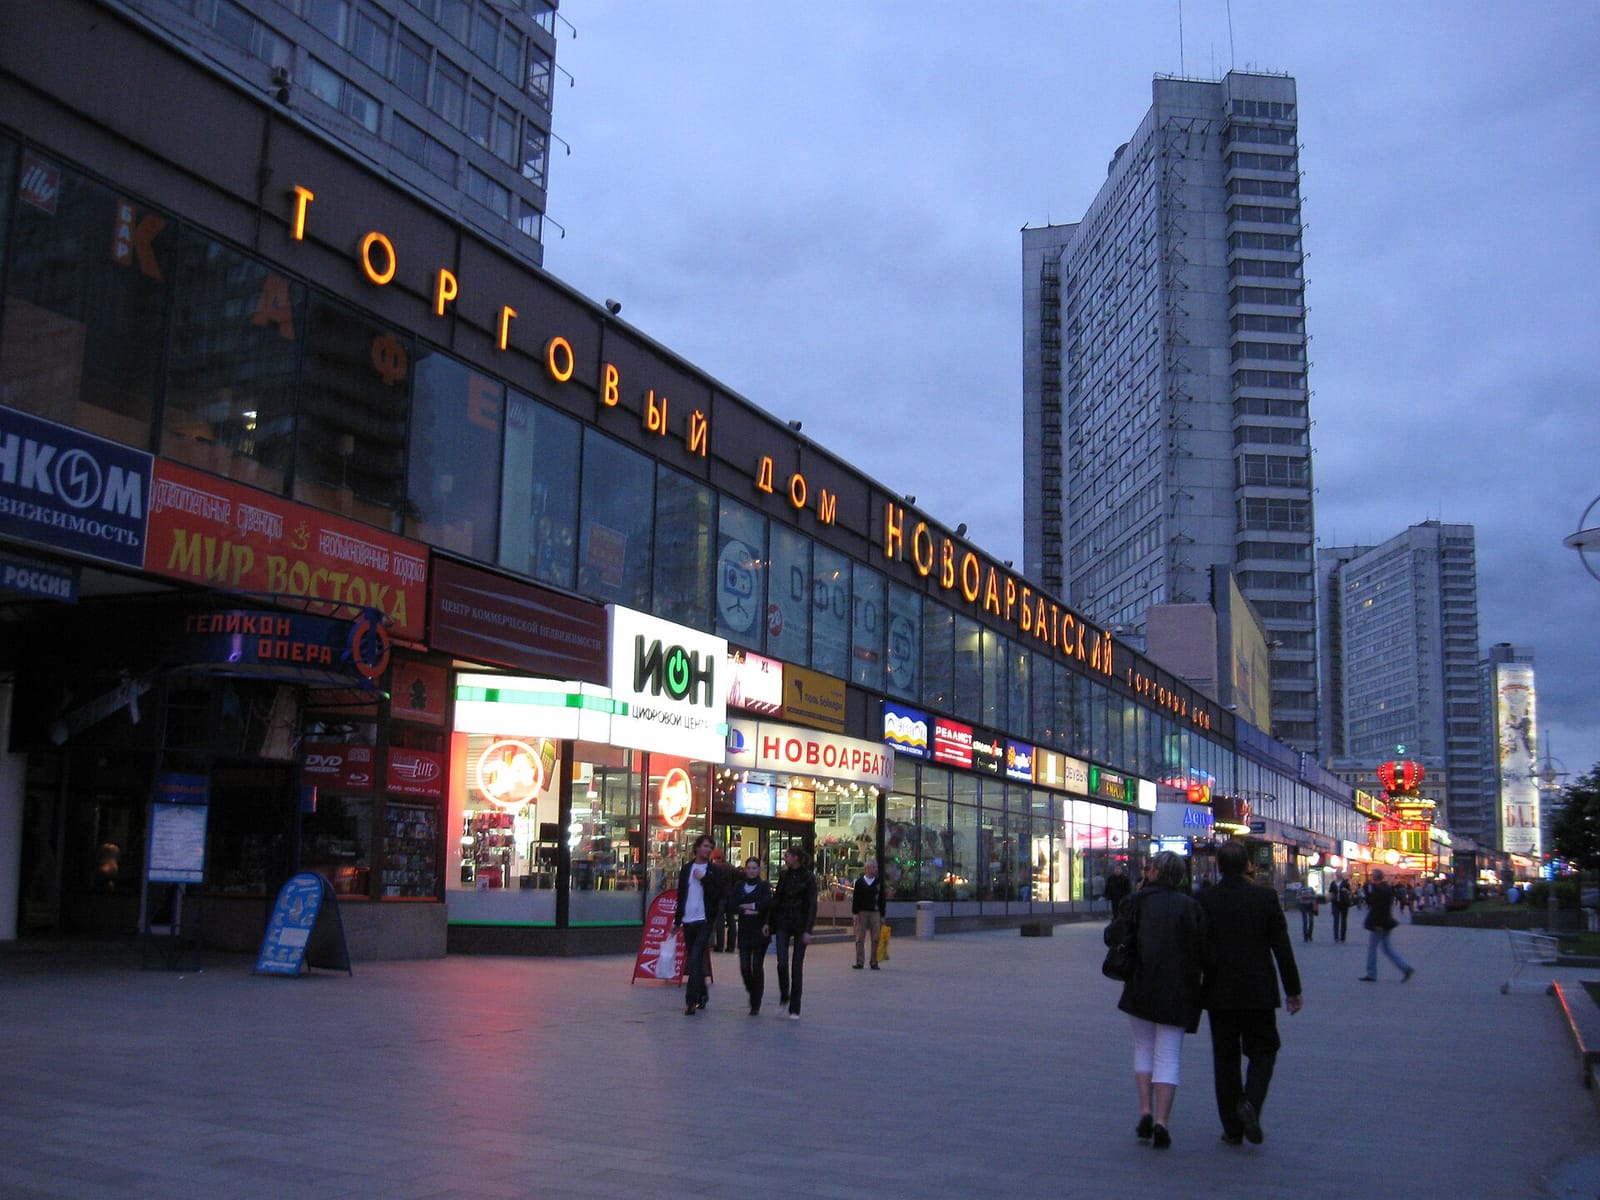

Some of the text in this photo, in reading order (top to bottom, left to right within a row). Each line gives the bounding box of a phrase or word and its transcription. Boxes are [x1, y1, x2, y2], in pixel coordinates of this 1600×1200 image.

[115, 204, 133, 259] БАР
[293, 185, 836, 526] ТОРГОВЫЙ ДОМ
[4, 565, 72, 598] РОССИЯ
[167, 528, 408, 629] МИР ВОСТОКА
[885, 502, 1113, 677] НОВОАРБАТСКИЙ
[186, 615, 291, 637] ГЕЛИКОН
[440, 599, 471, 616] ЦЕНТР
[471, 607, 539, 635] КОММЕРЧЕСКОЙ
[258, 639, 332, 665] ОПЕРА
[633, 634, 714, 708] ИОН
[305, 754, 344, 767] DVD
